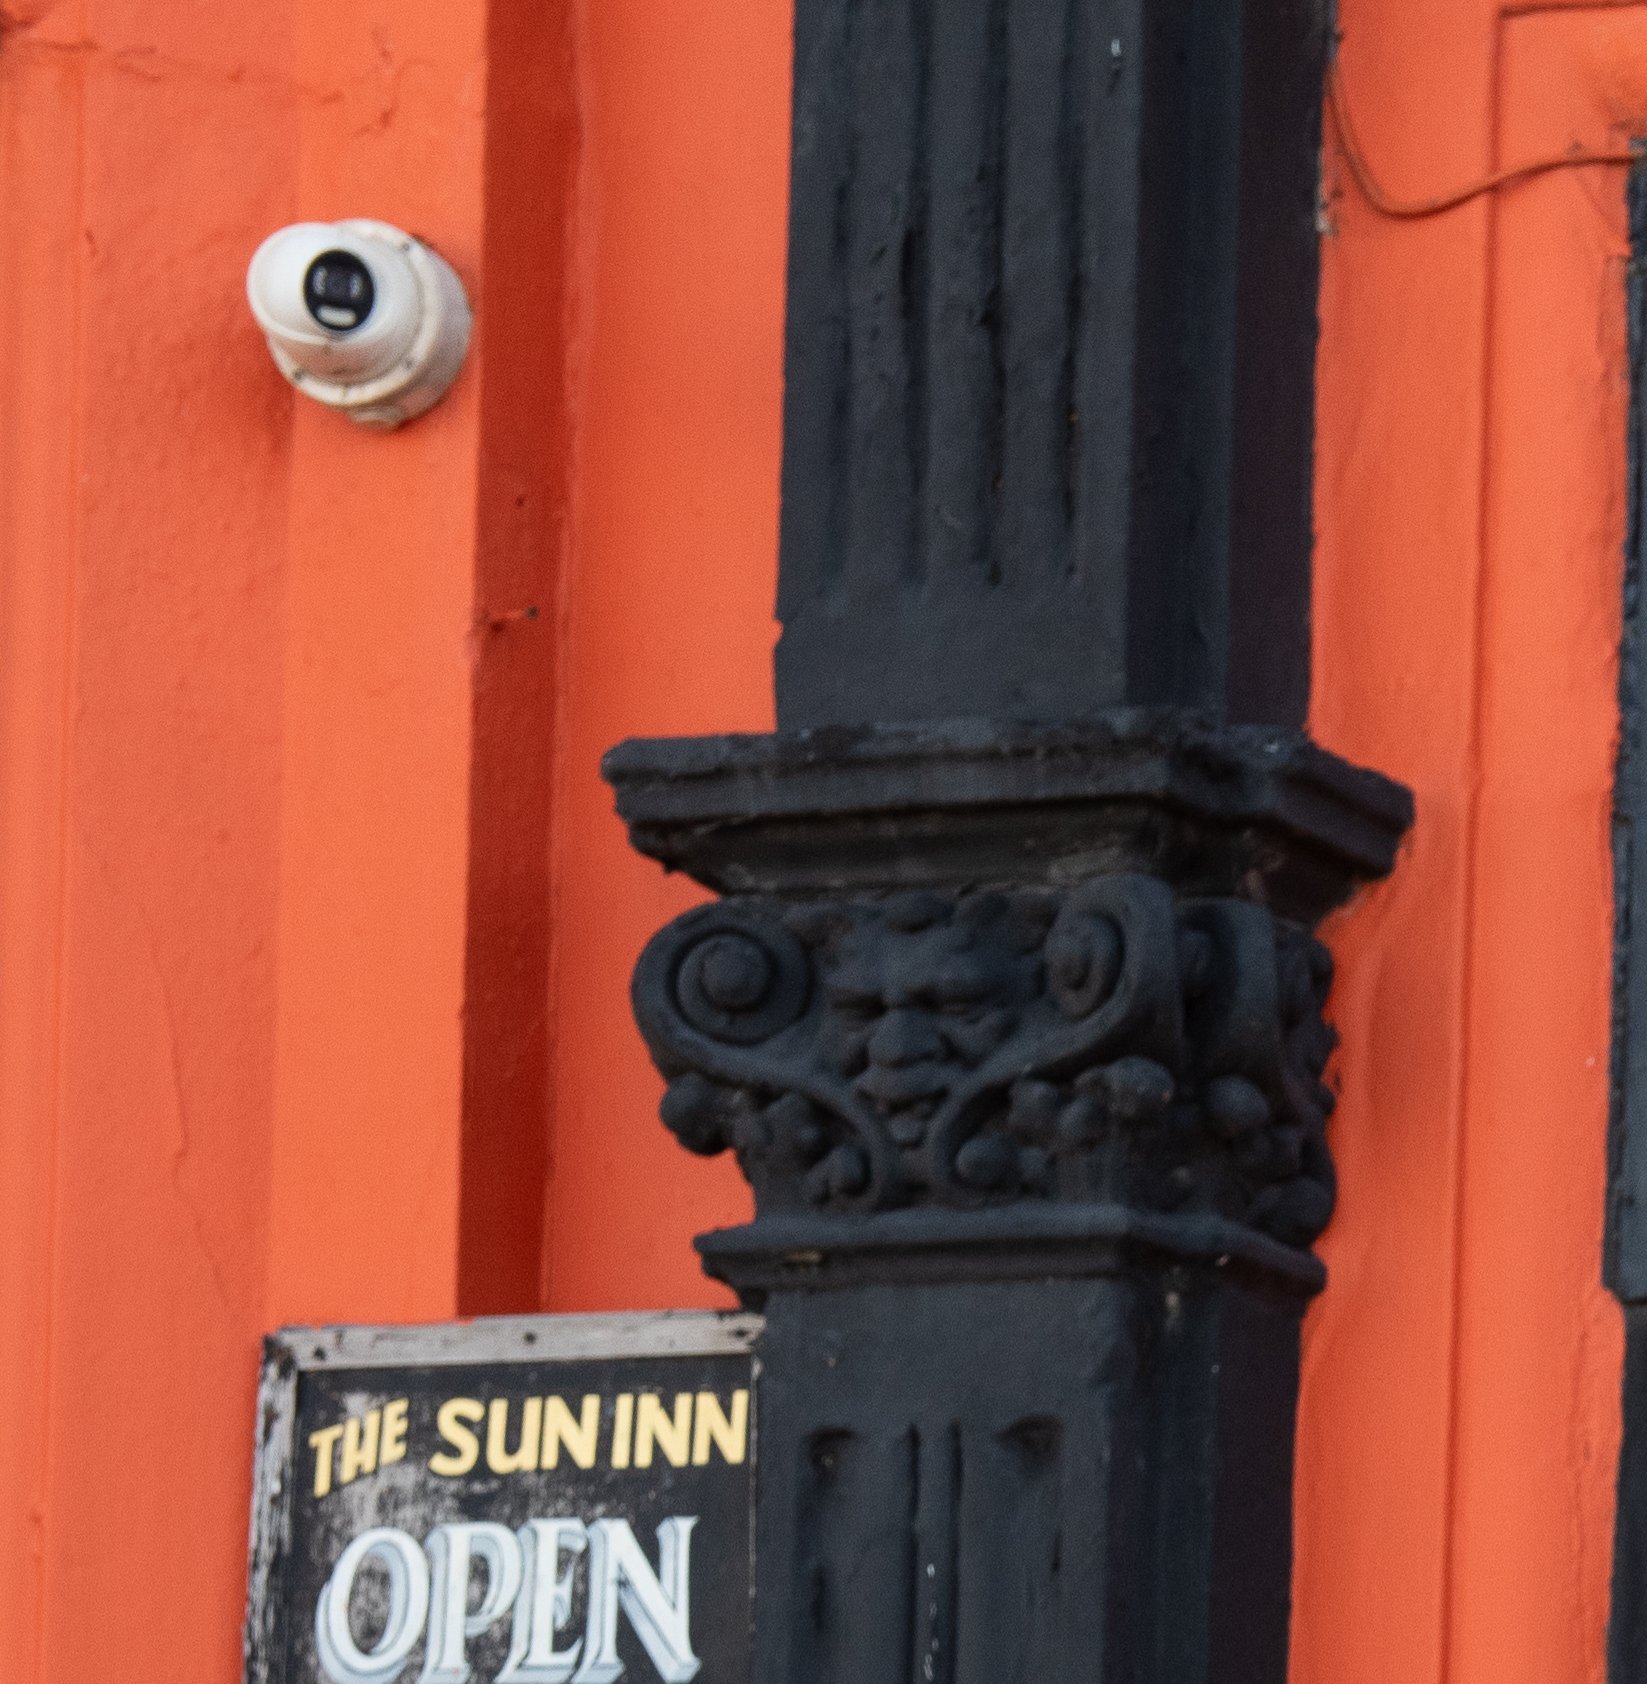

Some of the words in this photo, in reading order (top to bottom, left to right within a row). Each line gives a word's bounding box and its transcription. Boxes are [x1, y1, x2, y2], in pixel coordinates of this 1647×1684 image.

[309, 1398, 409, 1499] THE
[428, 1393, 599, 1477] SUN
[611, 1389, 748, 1469] INN
